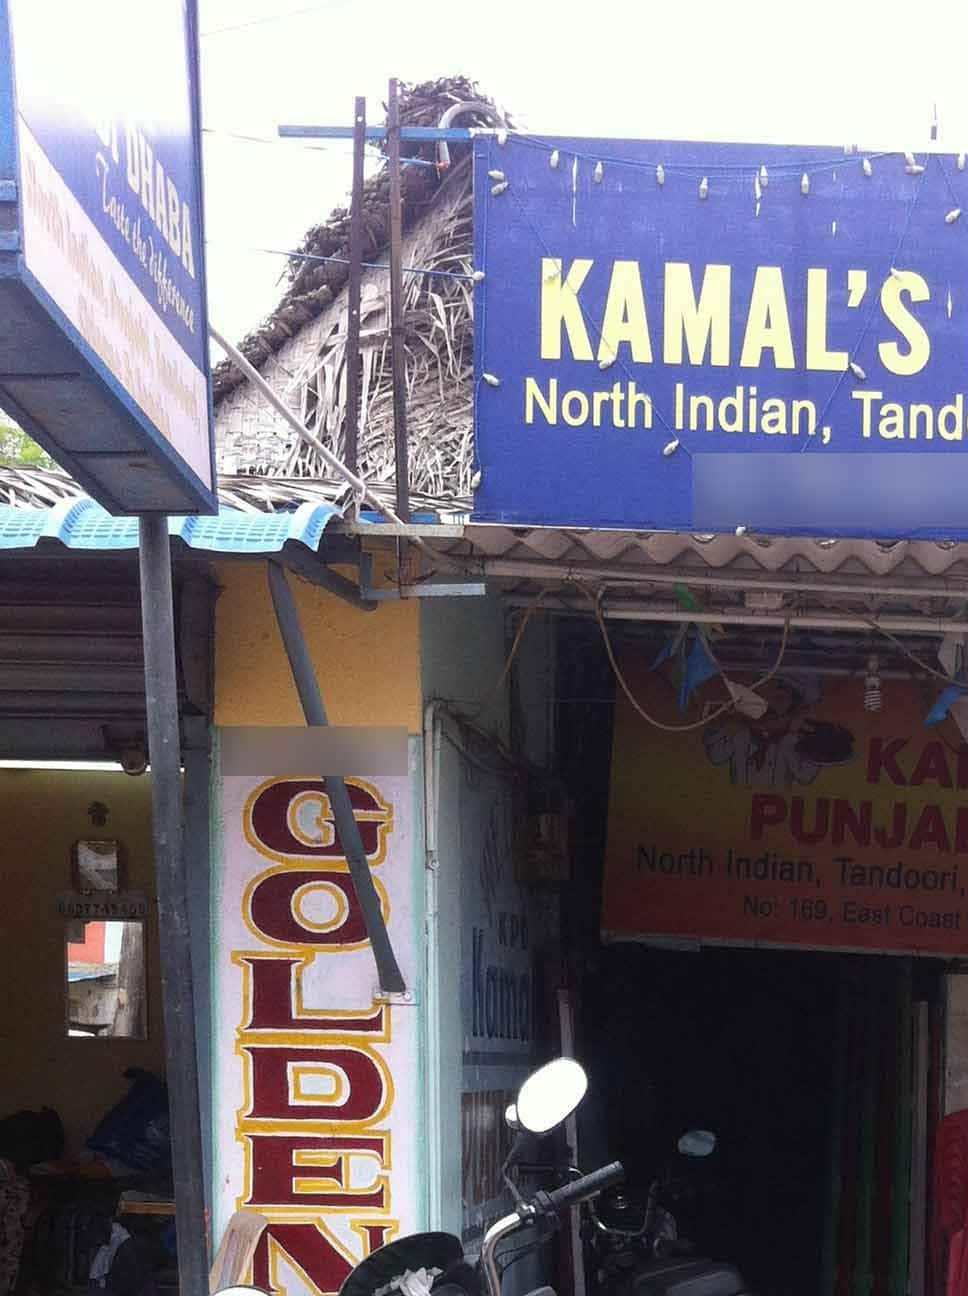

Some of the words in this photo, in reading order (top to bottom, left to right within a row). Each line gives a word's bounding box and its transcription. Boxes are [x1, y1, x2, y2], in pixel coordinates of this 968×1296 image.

[540, 257, 931, 377] KAMAL'S
[522, 377, 653, 429] North
[674, 384, 832, 443] Indian,
[636, 844, 714, 880] North
[727, 851, 822, 888] Indian,
[835, 857, 967, 897] Tandoori,
[843, 903, 892, 926] East
[899, 905, 960, 931] Coast
